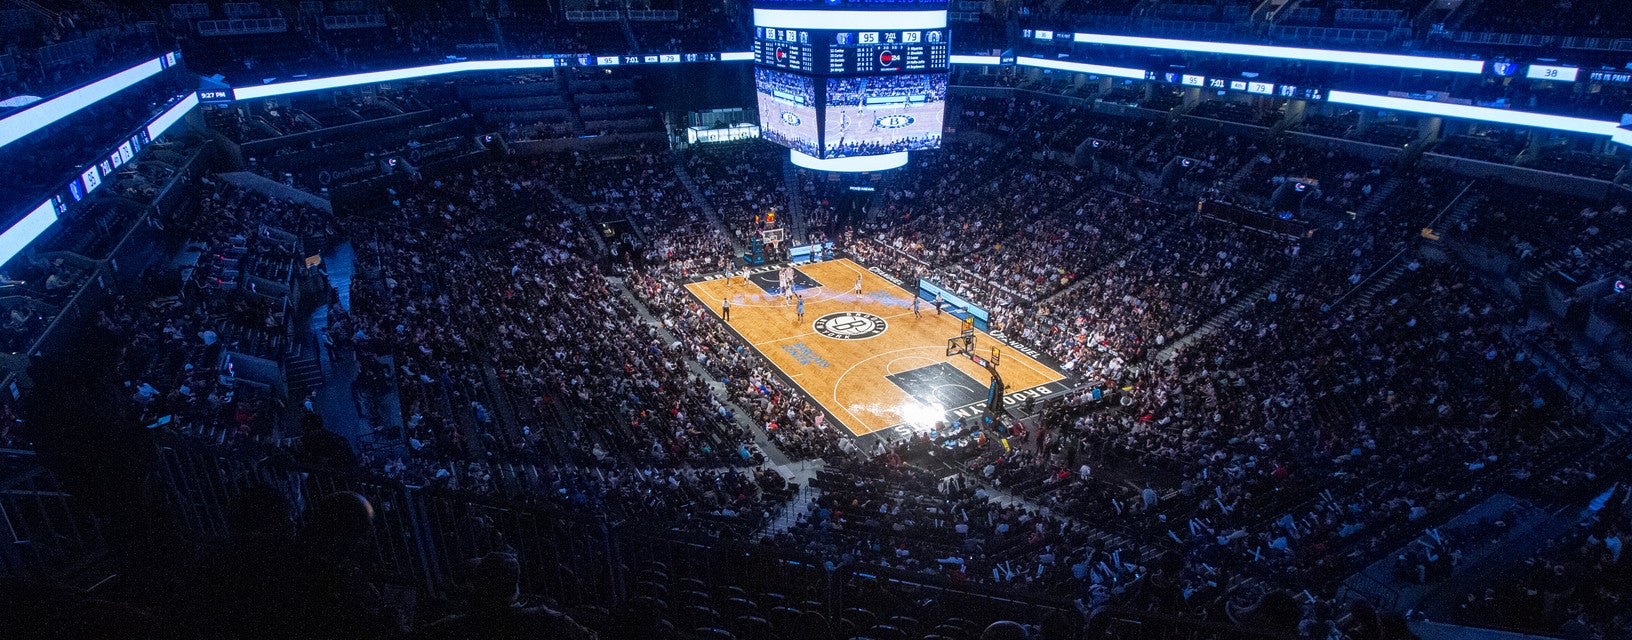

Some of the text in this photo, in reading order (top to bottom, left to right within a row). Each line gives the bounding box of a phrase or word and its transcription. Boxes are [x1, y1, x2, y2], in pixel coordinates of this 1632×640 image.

[863, 33, 875, 42] 95
[906, 33, 917, 42] 79
[1544, 68, 1558, 77] 38
[1590, 72, 1602, 81] PTS
[1612, 73, 1631, 83] PAINT
[1209, 79, 1225, 88] 7:01
[1256, 84, 1265, 92] 79
[953, 386, 1053, 419] BROOLYN
